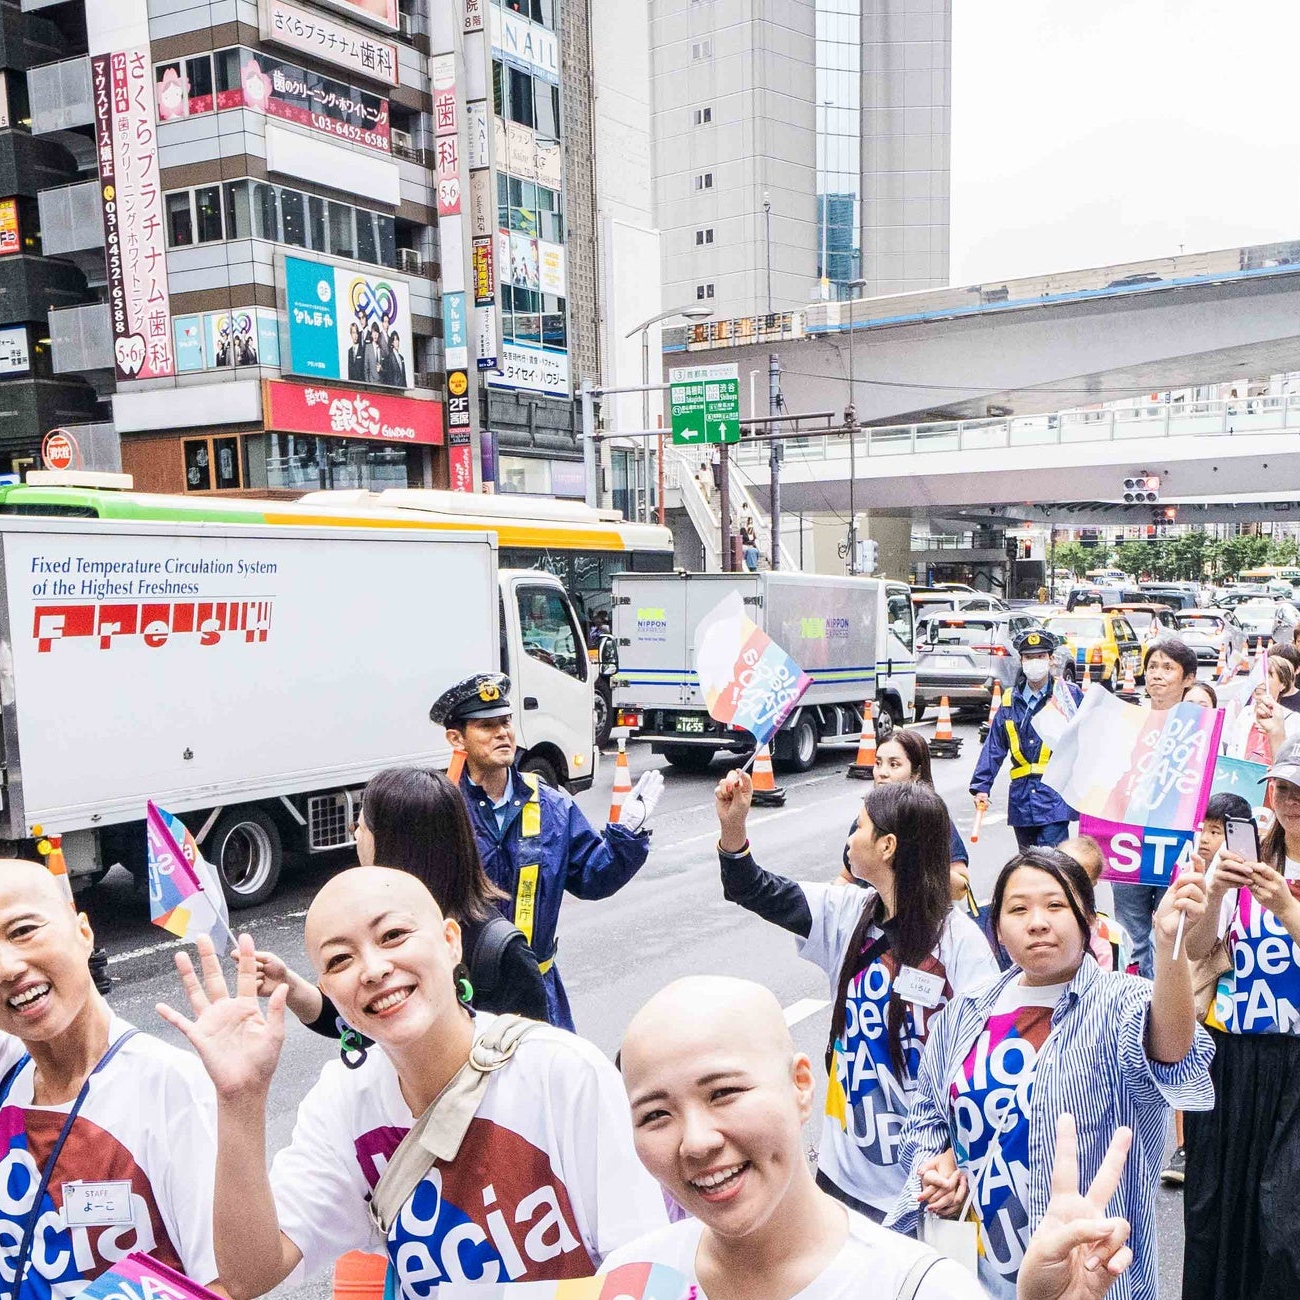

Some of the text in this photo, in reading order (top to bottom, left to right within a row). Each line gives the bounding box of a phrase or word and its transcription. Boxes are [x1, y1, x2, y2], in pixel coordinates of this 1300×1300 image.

[274, 11, 392, 77] さくらプラチナム歯科
[505, 22, 557, 69] NAIL
[93, 61, 114, 177] マウスピース矯正
[318, 116, 389, 150] 03-6452-6588
[130, 52, 172, 373] さくらプラチナム歯科
[105, 202, 125, 333] 03-6452-6588
[329, 395, 380, 435] 銀だこ
[449, 397, 468, 412] 2F
[31, 556, 278, 578] Fixed Temperature Circulation System
[32, 578, 200, 600] of the Highest Freshness
[638, 620, 666, 628] NIPPON
[826, 618, 849, 629] NIPPON
[682, 722, 704, 733] 16-55
[84, 1202, 115, 1212] よーこ
